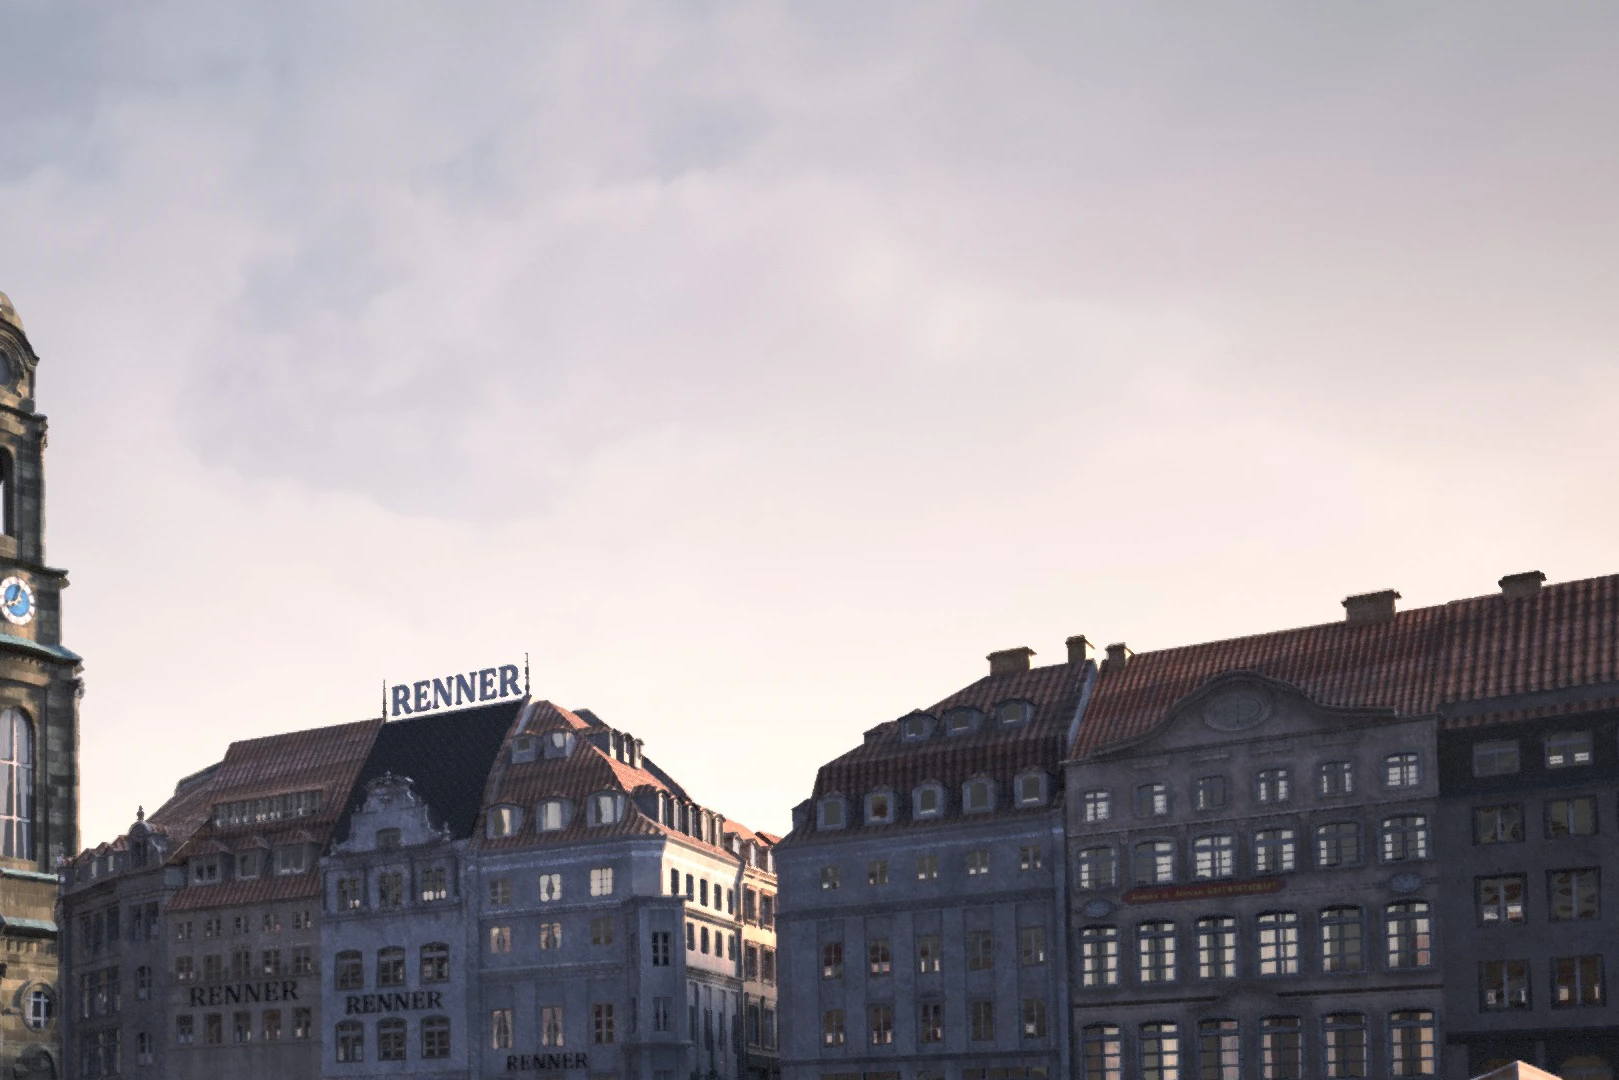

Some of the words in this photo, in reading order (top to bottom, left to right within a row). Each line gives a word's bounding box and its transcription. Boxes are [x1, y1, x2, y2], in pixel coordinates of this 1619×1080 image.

[391, 664, 522, 716] RENNER
[189, 980, 300, 1008] RENNER
[345, 991, 443, 1015] RENNER
[507, 1052, 588, 1072] RENNER
